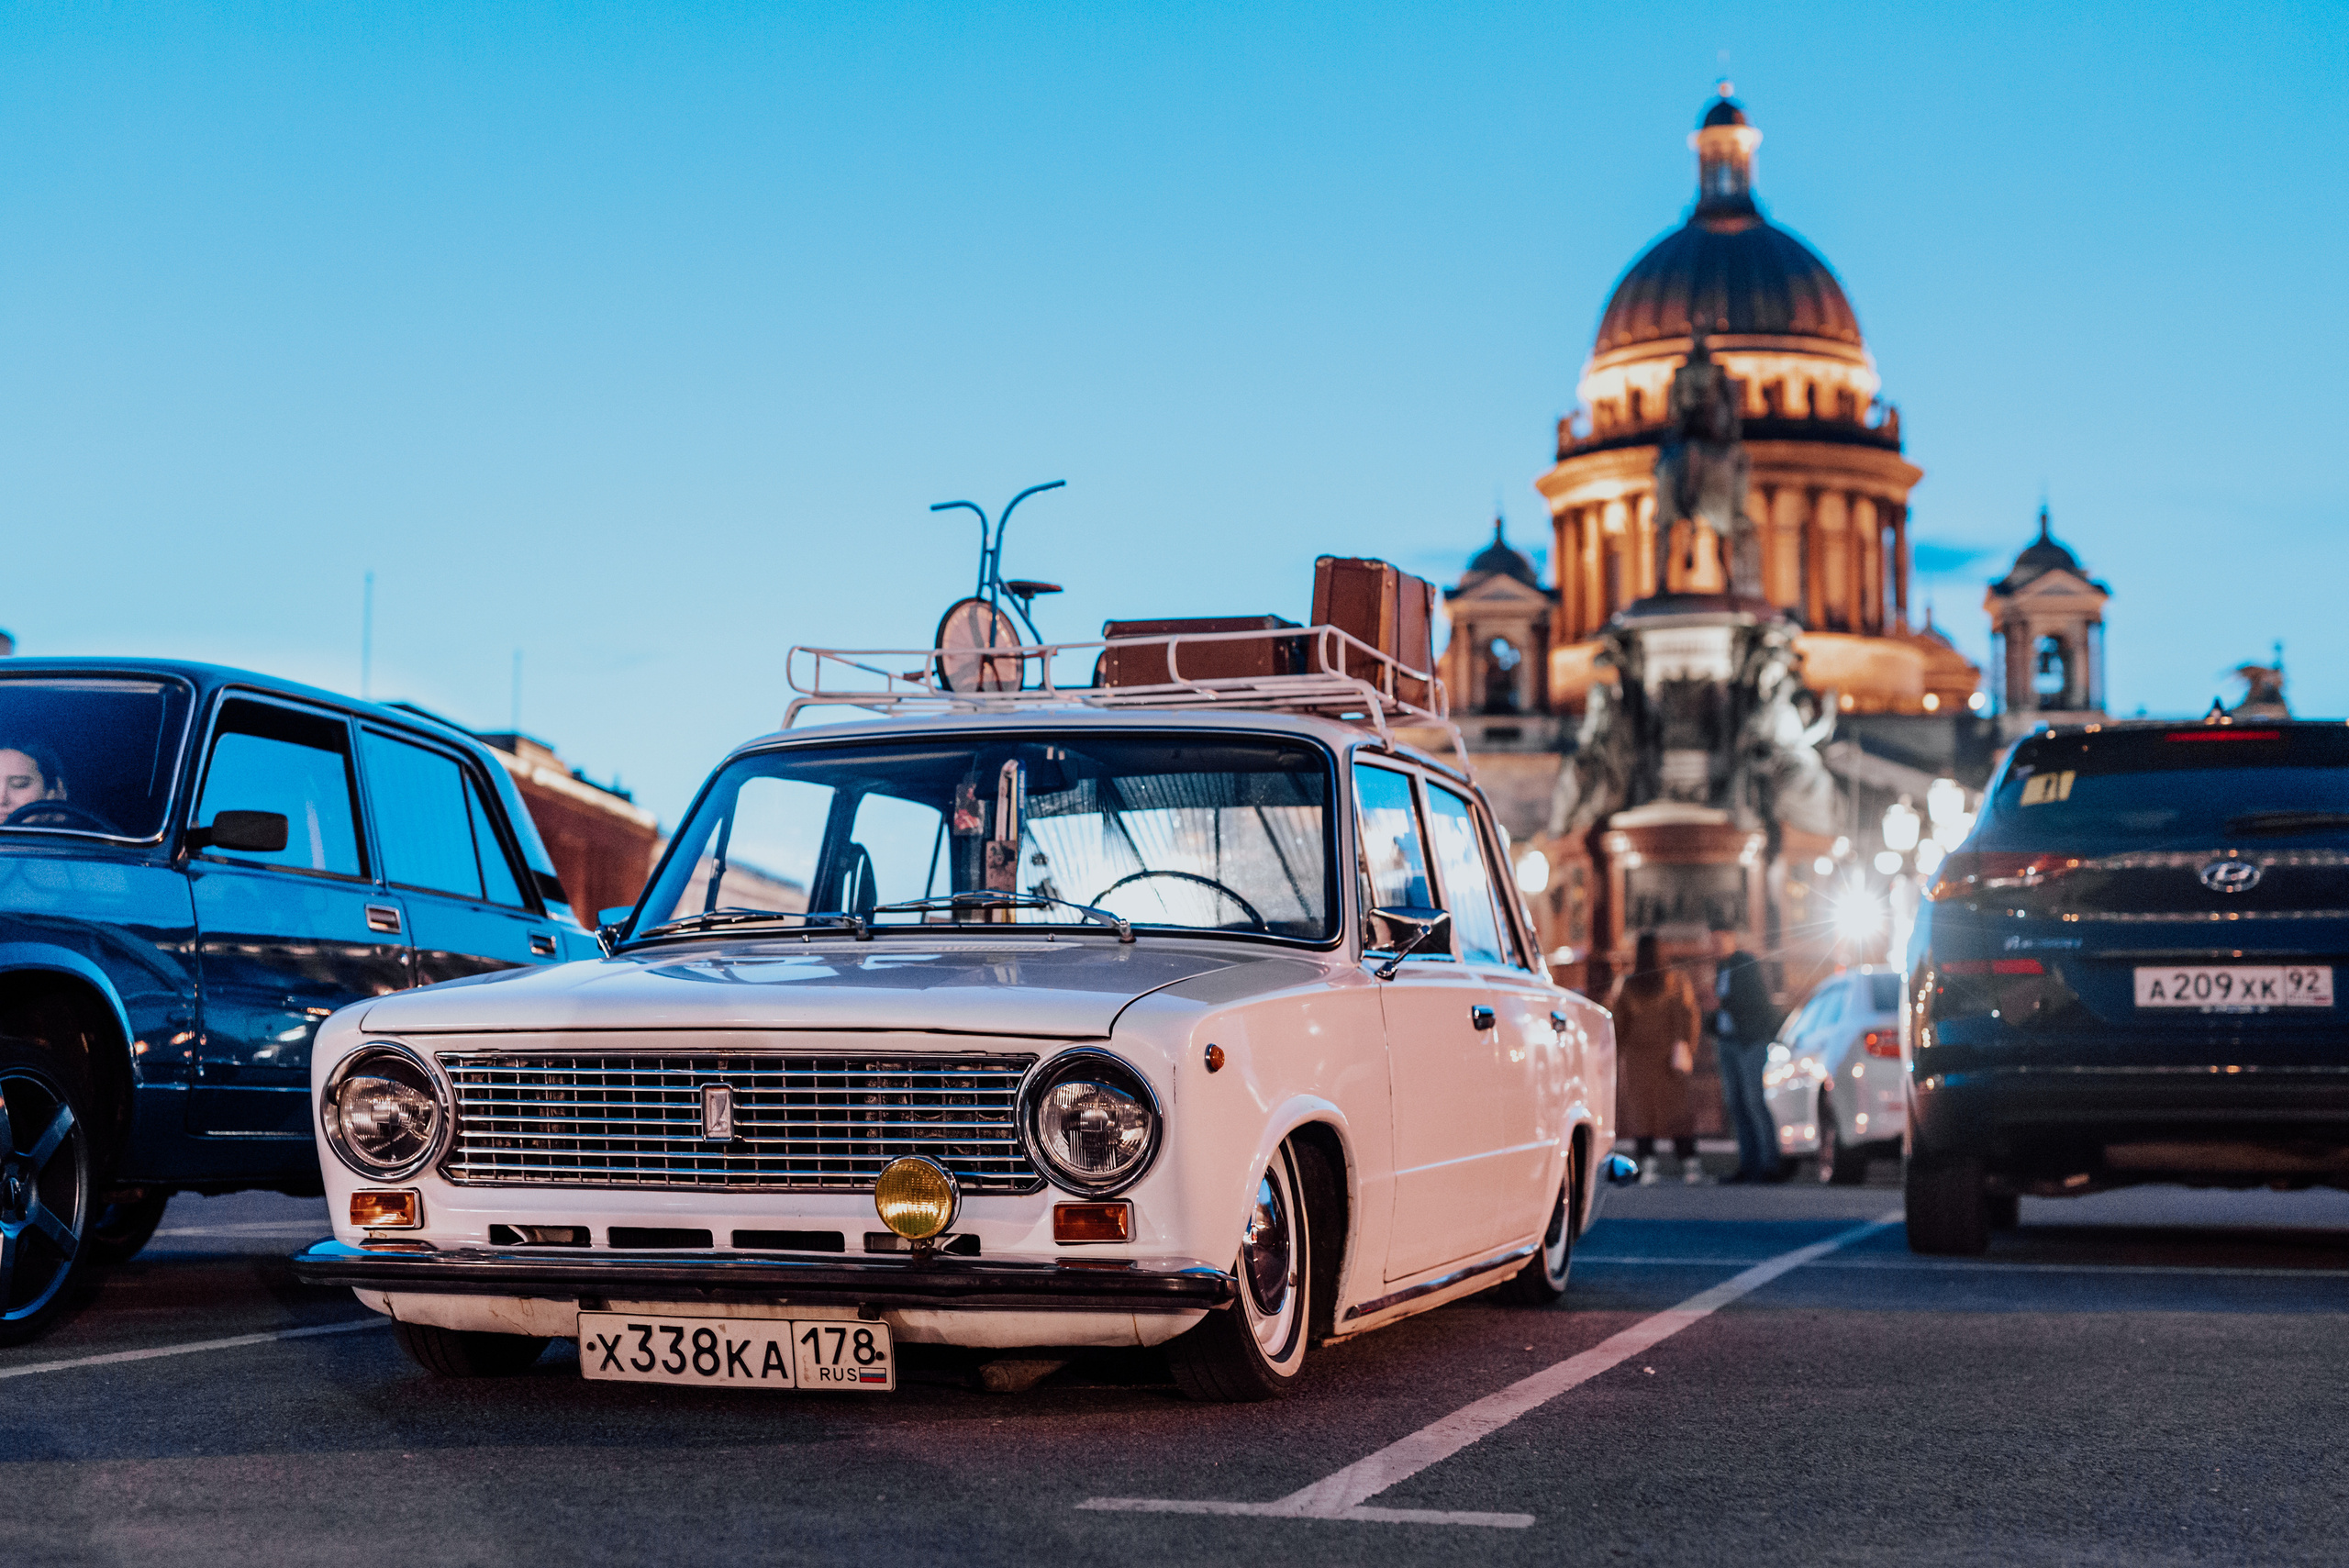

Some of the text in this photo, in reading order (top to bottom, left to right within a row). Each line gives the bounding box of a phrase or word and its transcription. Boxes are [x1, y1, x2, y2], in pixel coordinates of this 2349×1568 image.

[2288, 969, 2321, 993] 92
[596, 1323, 876, 1380] Х338КА 178
[819, 1367, 858, 1382] RUS
